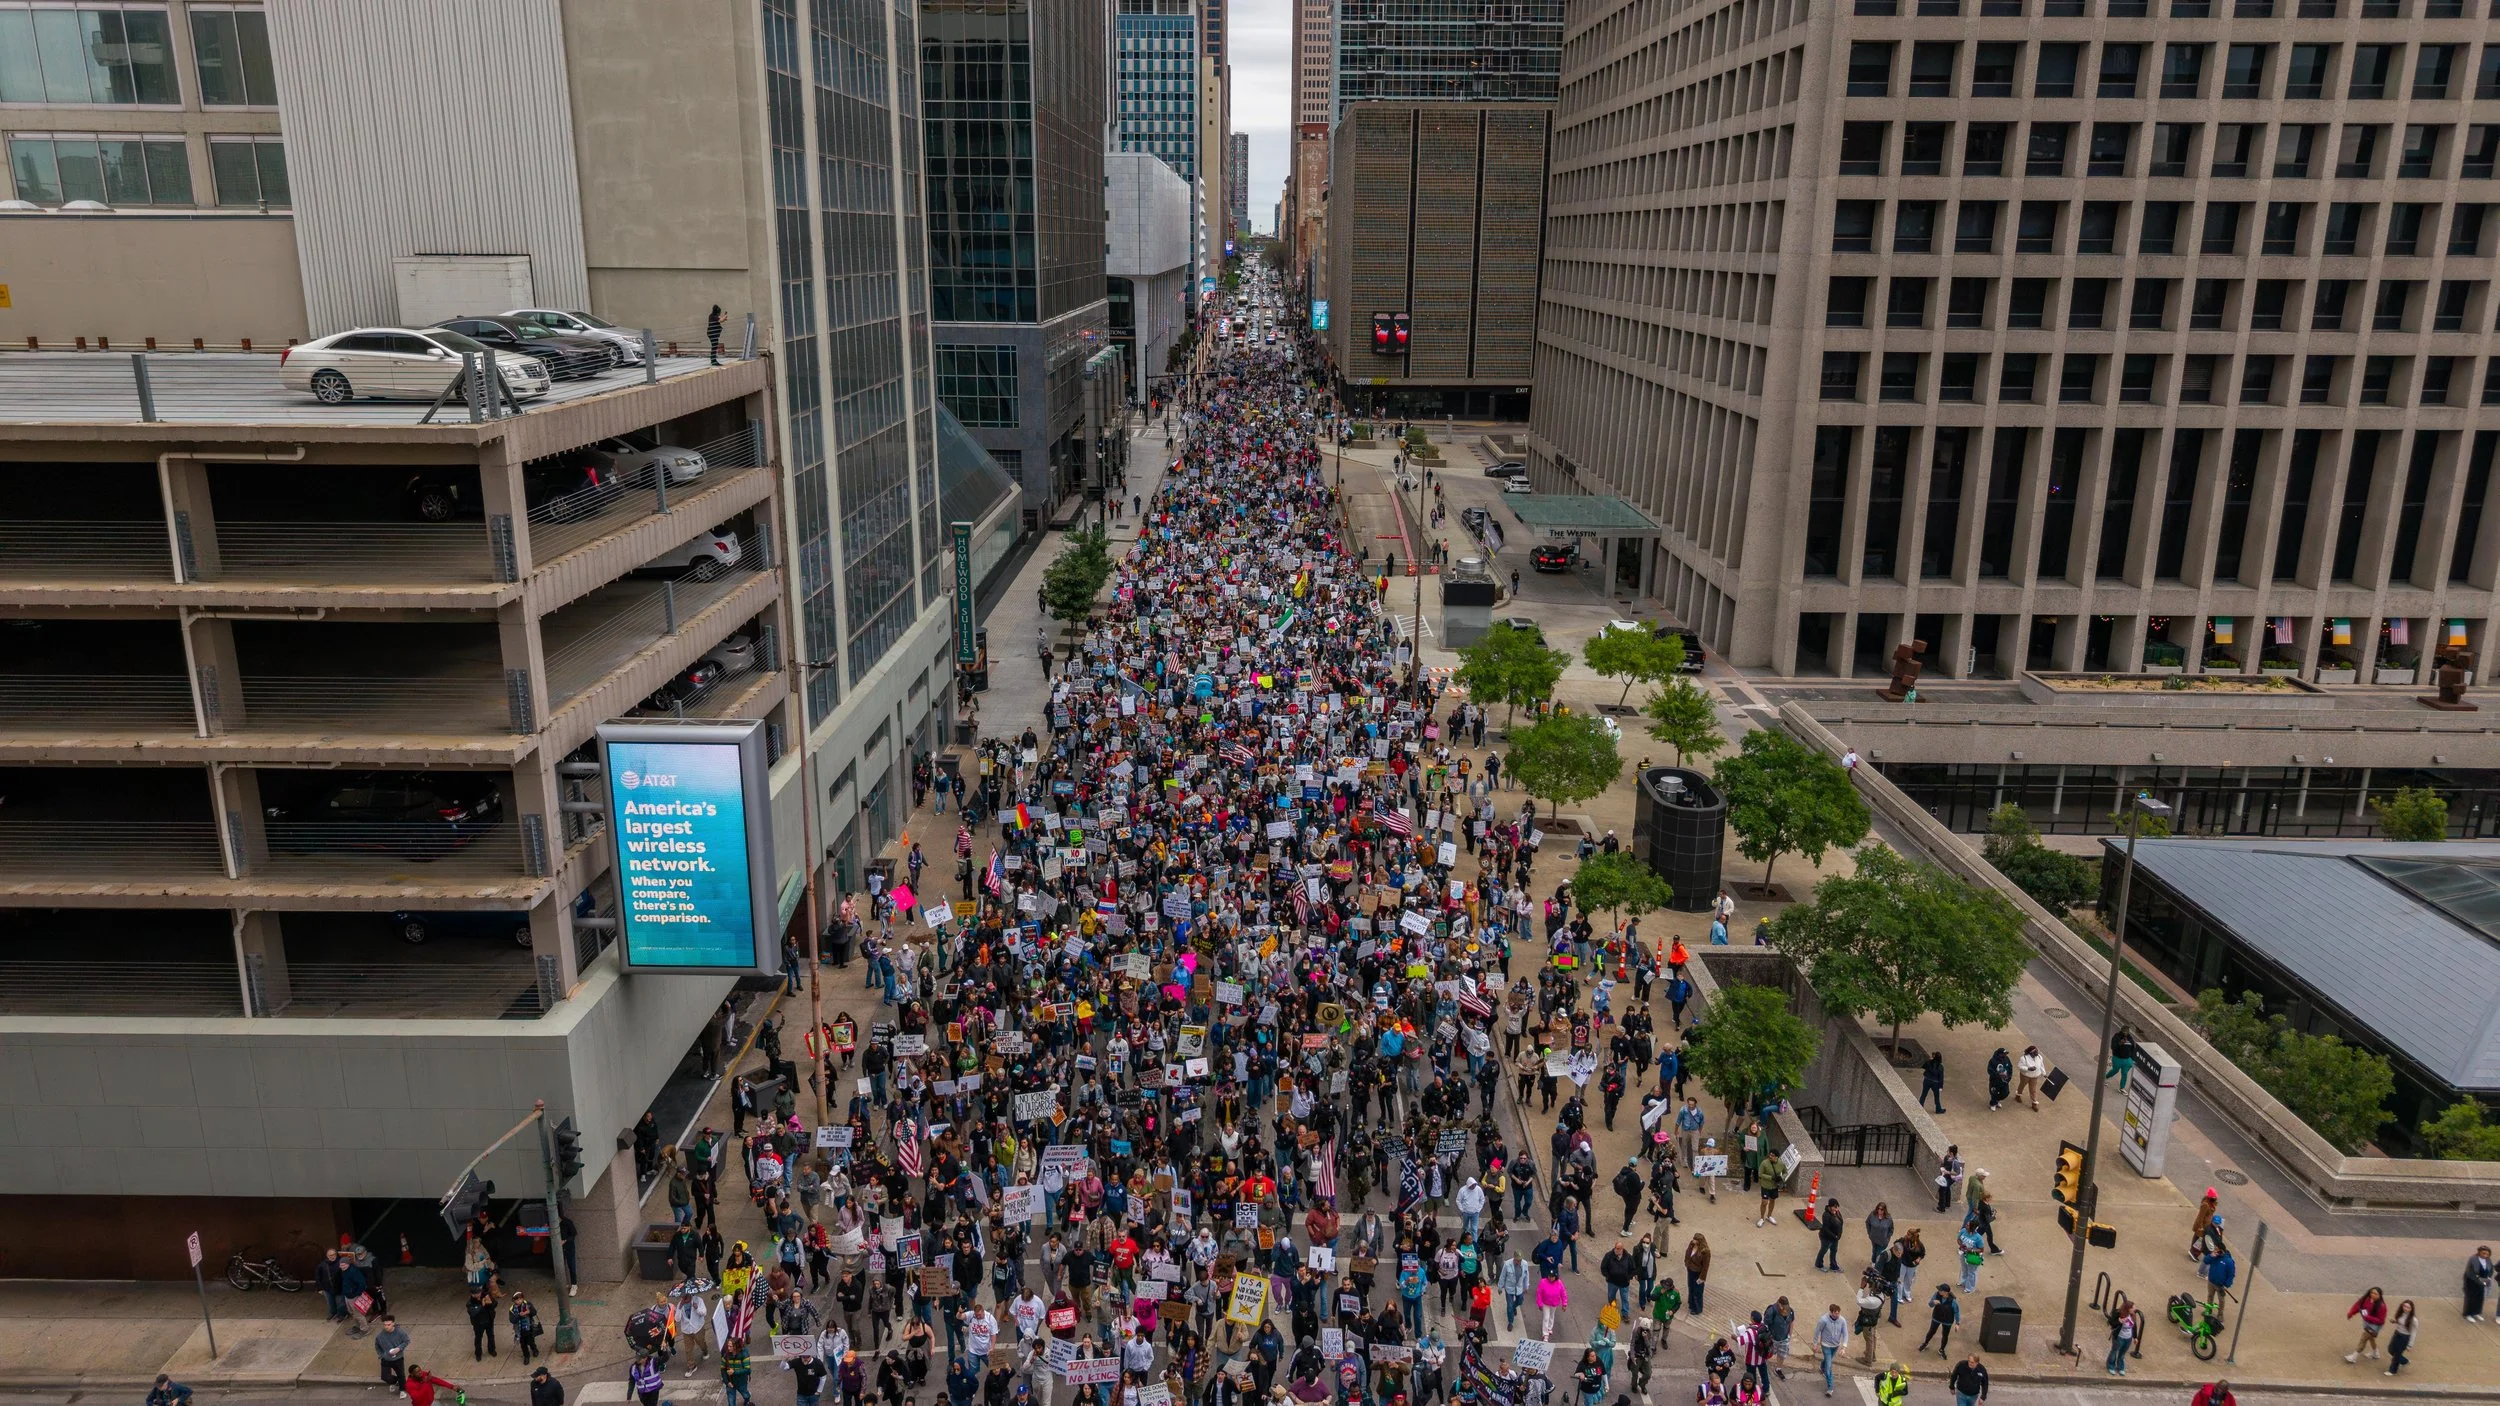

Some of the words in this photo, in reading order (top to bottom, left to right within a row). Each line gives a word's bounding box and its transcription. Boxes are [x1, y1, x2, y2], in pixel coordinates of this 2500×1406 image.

[1356, 377, 1390, 385] SUBWAY
[958, 538, 968, 600] HOMEWOOD
[642, 774, 678, 786] AT&T
[624, 800, 717, 816] America’s
[626, 818, 693, 838] largest
[628, 838, 706, 854] wireless
[630, 857, 716, 872] network.
[631, 876, 666, 886] When
[670, 878, 692, 888] you
[632, 890, 690, 900] compare,
[633, 900, 676, 910] there’s
[679, 902, 694, 910] no
[634, 913, 711, 924] comparison.
[1020, 1094, 1028, 1102] NO
[1030, 1092, 1050, 1101] KINGS
[1005, 1192, 1020, 1201] GUNS
[1246, 1288, 1263, 1297] KINGS
[1244, 1295, 1262, 1304] TRUMP
[774, 1341, 812, 1349] PEDO
[1519, 1340, 1544, 1349] MAKE
[1514, 1352, 1544, 1361] NORMAL
[1517, 1345, 1550, 1357] AMERICA
[1068, 1361, 1089, 1371] 1776
[1092, 1358, 1120, 1368] CALLED
[1069, 1375, 1083, 1383] NO
[1088, 1370, 1119, 1382] KINGS
